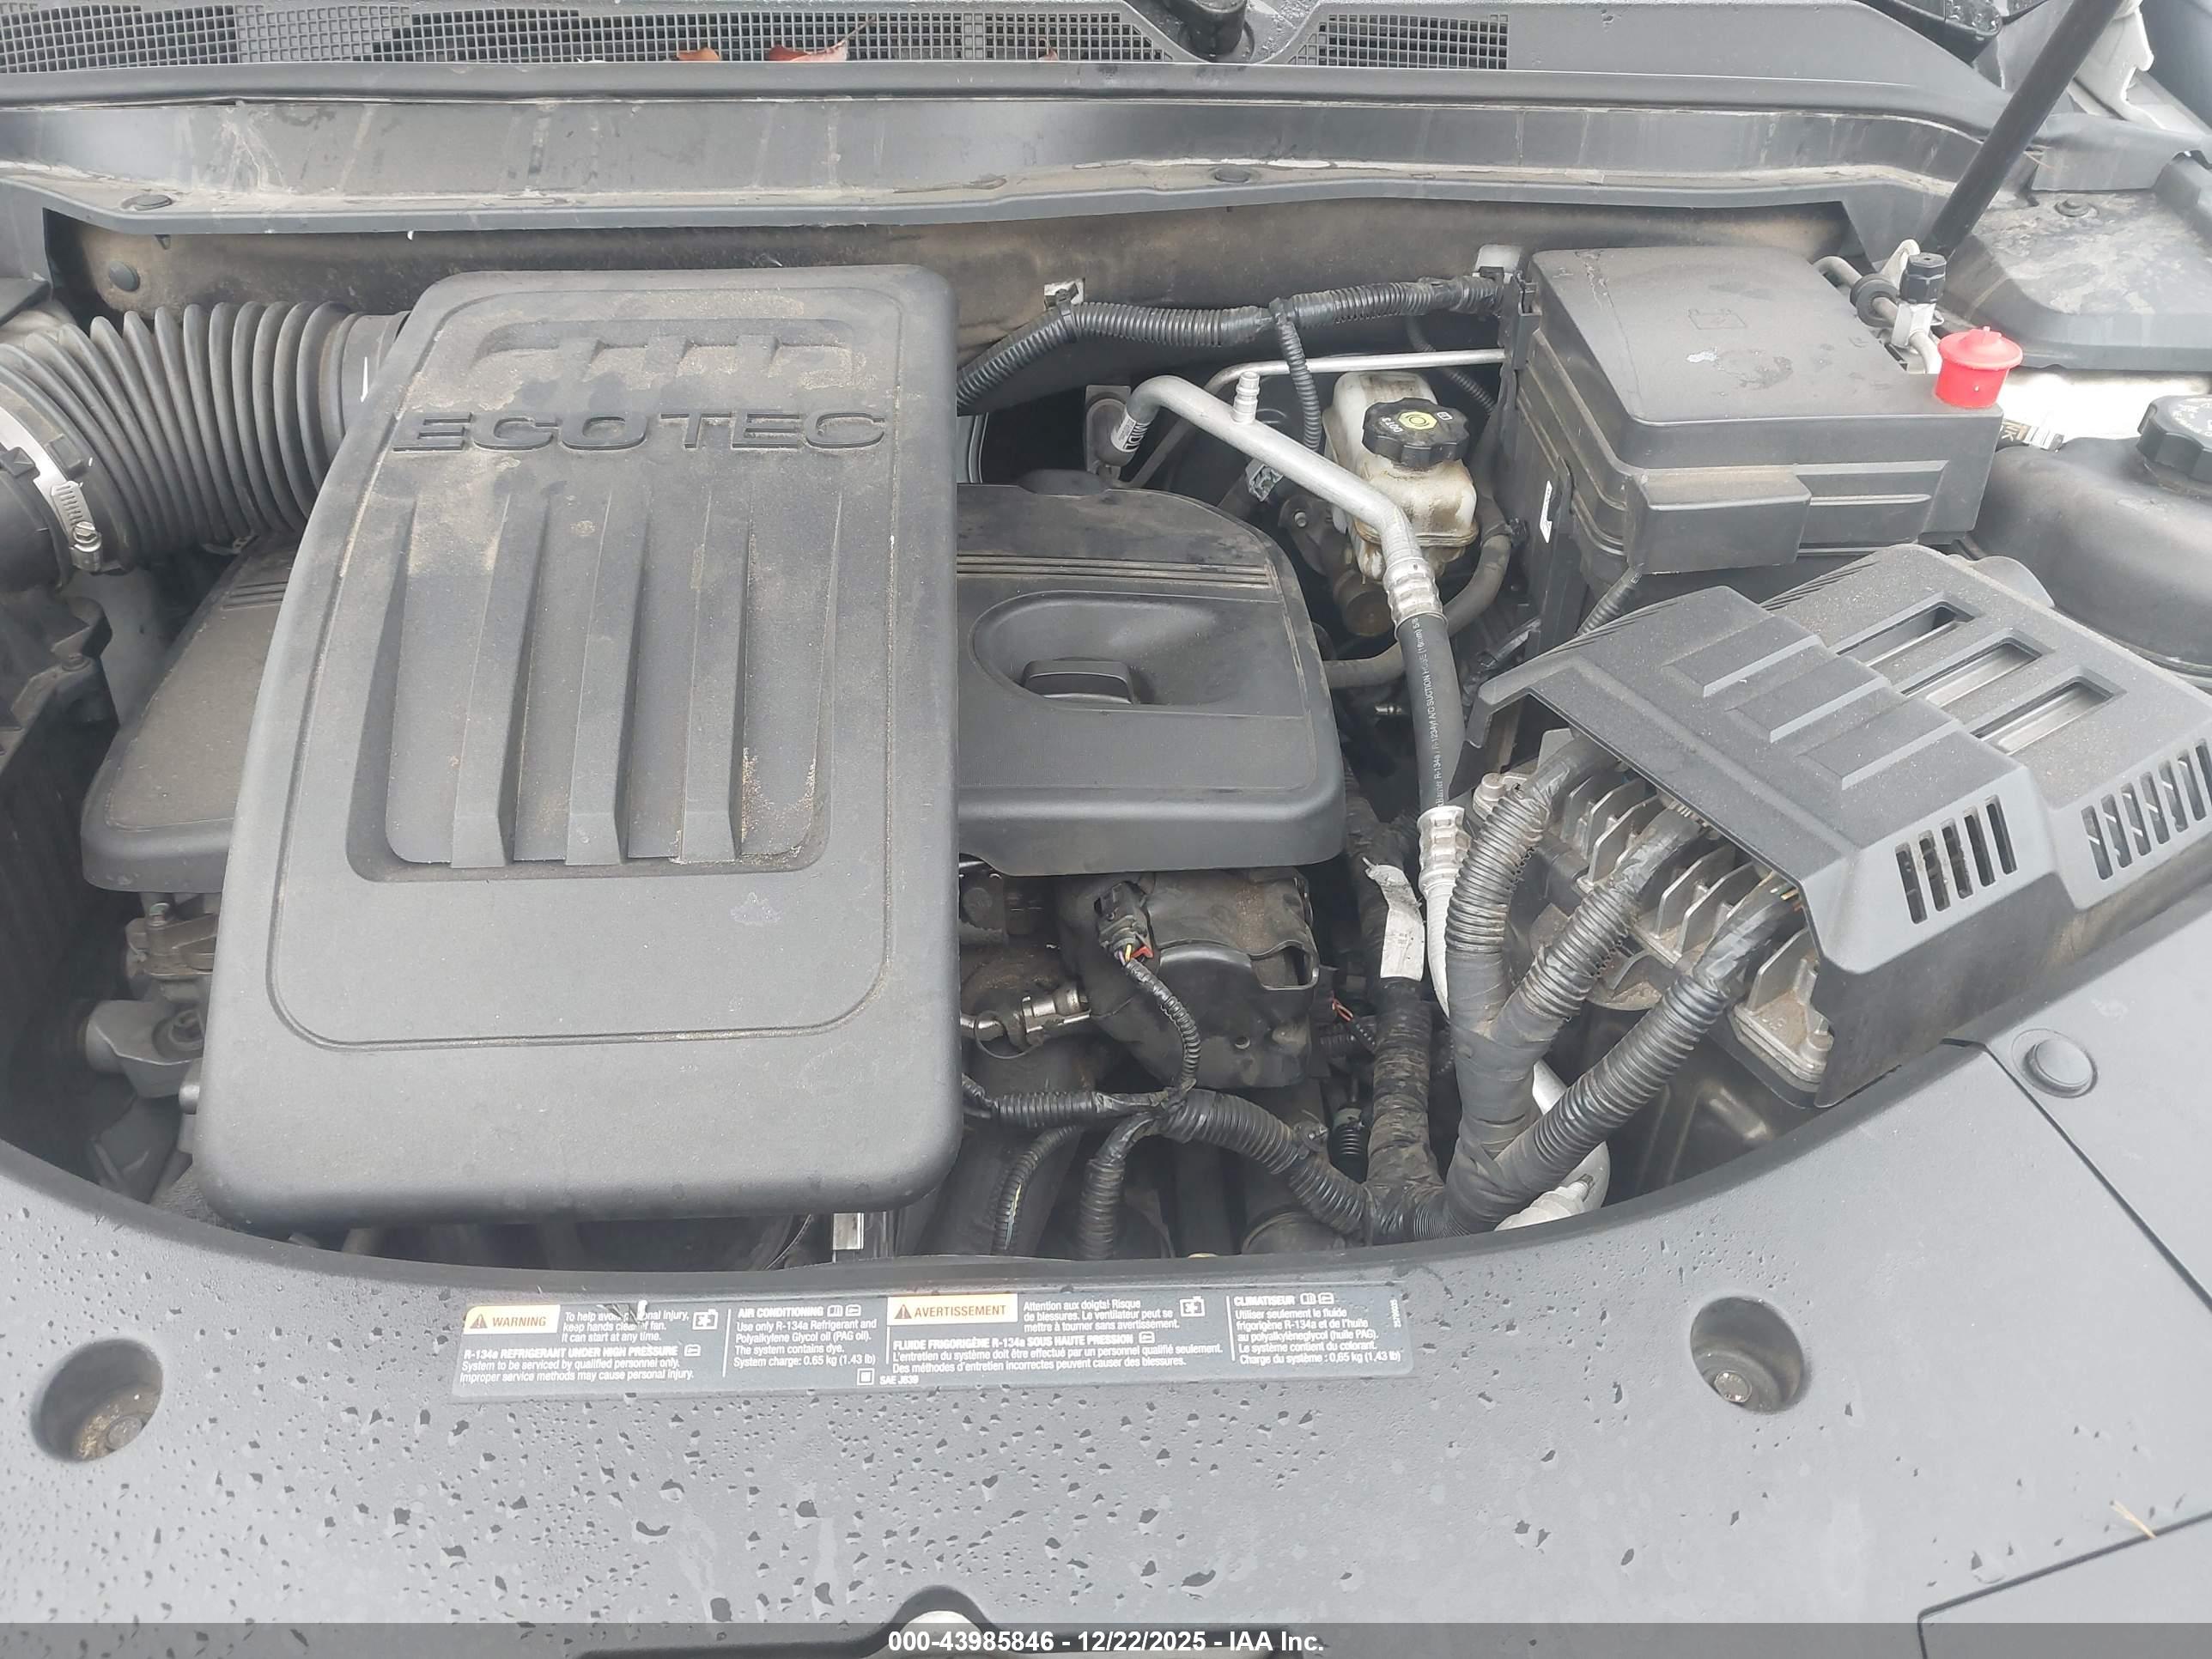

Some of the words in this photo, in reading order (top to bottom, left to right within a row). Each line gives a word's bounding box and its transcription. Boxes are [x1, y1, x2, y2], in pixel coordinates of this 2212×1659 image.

[392, 411, 887, 453] ECOTEC
[1423, 674, 1435, 706] SUCTION
[1024, 1301, 1062, 1311] Attention
[1064, 1301, 1079, 1310] aux
[1081, 1300, 1110, 1311] doigts!
[1111, 1298, 1141, 1310] Risque
[1234, 1295, 1296, 1306] CLIMATISEUR
[565, 1311, 574, 1322] To
[578, 1311, 596, 1323] help
[623, 1310, 661, 1323] ponal
[663, 1310, 690, 1322] injury,
[738, 1308, 755, 1319] AIR
[757, 1306, 824, 1318] CONDITIONING
[915, 1304, 1006, 1317] AVERTISSEMENT
[1024, 1312, 1035, 1322] de
[1036, 1311, 1080, 1322] blessures.
[1082, 1310, 1093, 1320] Le
[1095, 1310, 1139, 1321] ventilateur
[1141, 1310, 1161, 1321] peut
[1163, 1310, 1174, 1319] se
[1236, 1310, 1264, 1320] Utiliser
[1266, 1309, 1312, 1319] seulement
[1313, 1309, 1322, 1317] le
[1323, 1308, 1346, 1318] fluide
[492, 1316, 547, 1327] WARNING
[562, 1323, 585, 1334] keep
[587, 1322, 614, 1332] hands
[616, 1322, 638, 1331] clea
[650, 1322, 666, 1331] fan.
[737, 1322, 753, 1332] Use
[756, 1321, 774, 1334] only
[776, 1321, 808, 1331] R-134a
[811, 1319, 859, 1331] Refrigerant
[860, 1319, 878, 1329] and
[1024, 1322, 1052, 1333] mettre
[1054, 1321, 1060, 1330] à
[1061, 1321, 1093, 1331] tourner
[1095, 1322, 1115, 1330] sans
[1117, 1319, 1180, 1329] avertissement.
[1237, 1320, 1282, 1332] frigorigène
[1285, 1320, 1316, 1330] R-134a
[1318, 1320, 1328, 1329] et
[1329, 1319, 1340, 1328] de
[1342, 1319, 1368, 1328] l'huile
[562, 1334, 568, 1343] It
[570, 1334, 586, 1343] can
[588, 1333, 609, 1342] start
[611, 1333, 620, 1341] at
[622, 1334, 638, 1344] any
[639, 1332, 661, 1341] time.
[736, 1333, 790, 1346] Polyalkylene
[792, 1333, 818, 1344] Glycol
[820, 1332, 831, 1341] oil
[833, 1332, 854, 1343] (PAG
[855, 1331, 872, 1341] oil).
[893, 1340, 927, 1351] FLUIDE
[928, 1337, 990, 1349] FRIGORIGÈNE
[992, 1337, 1025, 1348] R-134a
[1027, 1336, 1054, 1346] SOUS
[1054, 1335, 1085, 1346] HAUTE
[1087, 1334, 1133, 1345] PRESSION
[1237, 1334, 1249, 1342] au
[1251, 1330, 1329, 1344] polyalkylèneglycol
[1330, 1330, 1354, 1341] (huile
[1355, 1329, 1379, 1340] PAG).
[464, 1349, 498, 1359] R-134a
[501, 1348, 567, 1358] REFRIGERANT
[568, 1347, 601, 1358] UNDER
[603, 1346, 626, 1358] HIGH
[628, 1346, 678, 1357] PRESSURE
[735, 1345, 751, 1355] The
[753, 1345, 785, 1356] system
[787, 1344, 824, 1353] contains
[826, 1343, 845, 1354] dye.
[893, 1351, 939, 1362] L'entretien
[940, 1350, 952, 1360] du
[953, 1349, 990, 1362] système
[993, 1349, 1009, 1359] doit
[1011, 1348, 1028, 1358] être
[1030, 1347, 1066, 1358] effectué
[1067, 1347, 1081, 1358] par
[1085, 1348, 1096, 1357] un
[1097, 1346, 1140, 1358] personnel
[1142, 1344, 1173, 1356] qualifié
[1175, 1343, 1223, 1354] seulement.
[1239, 1344, 1250, 1353] Le
[1251, 1342, 1288, 1355] système
[1290, 1342, 1325, 1352] contient
[1326, 1342, 1338, 1351] du
[1339, 1341, 1377, 1351] colorant.
[462, 1360, 495, 1372] System
[497, 1361, 506, 1370] to
[508, 1360, 520, 1370] be
[521, 1359, 560, 1370] serviced
[562, 1359, 573, 1371] by
[574, 1358, 612, 1370] qualified
[614, 1358, 658, 1370] personnel
[659, 1357, 680, 1369] only.
[733, 1357, 766, 1369] System
[769, 1356, 802, 1367] charge:
[803, 1356, 824, 1366] 0.65
[826, 1356, 837, 1367] kg
[839, 1355, 863, 1365] (1.43
[864, 1354, 876, 1365] lb)
[893, 1363, 910, 1374] Des
[912, 1362, 955, 1373] méthodes
[957, 1361, 1004, 1372] d'entretien
[1006, 1359, 1054, 1370] incorrectes
[1056, 1358, 1091, 1370] peuvent
[1092, 1358, 1121, 1368] causer
[1124, 1357, 1140, 1367] des
[1142, 1356, 1187, 1367] blessures.
[1239, 1354, 1271, 1366] Charge
[1273, 1354, 1285, 1364] du
[1286, 1353, 1322, 1366] système
[1329, 1352, 1350, 1364] 0,65
[1352, 1352, 1364, 1364] kg
[1364, 1352, 1388, 1363] (1,43
[1389, 1351, 1401, 1362] lb)
[460, 1372, 501, 1384] Improper
[502, 1372, 534, 1382] service
[537, 1371, 575, 1382] methods
[577, 1371, 598, 1382] may
[599, 1371, 626, 1381] cause
[627, 1370, 665, 1381] personal
[668, 1369, 695, 1381] injury.
[879, 1375, 896, 1385] SAE
